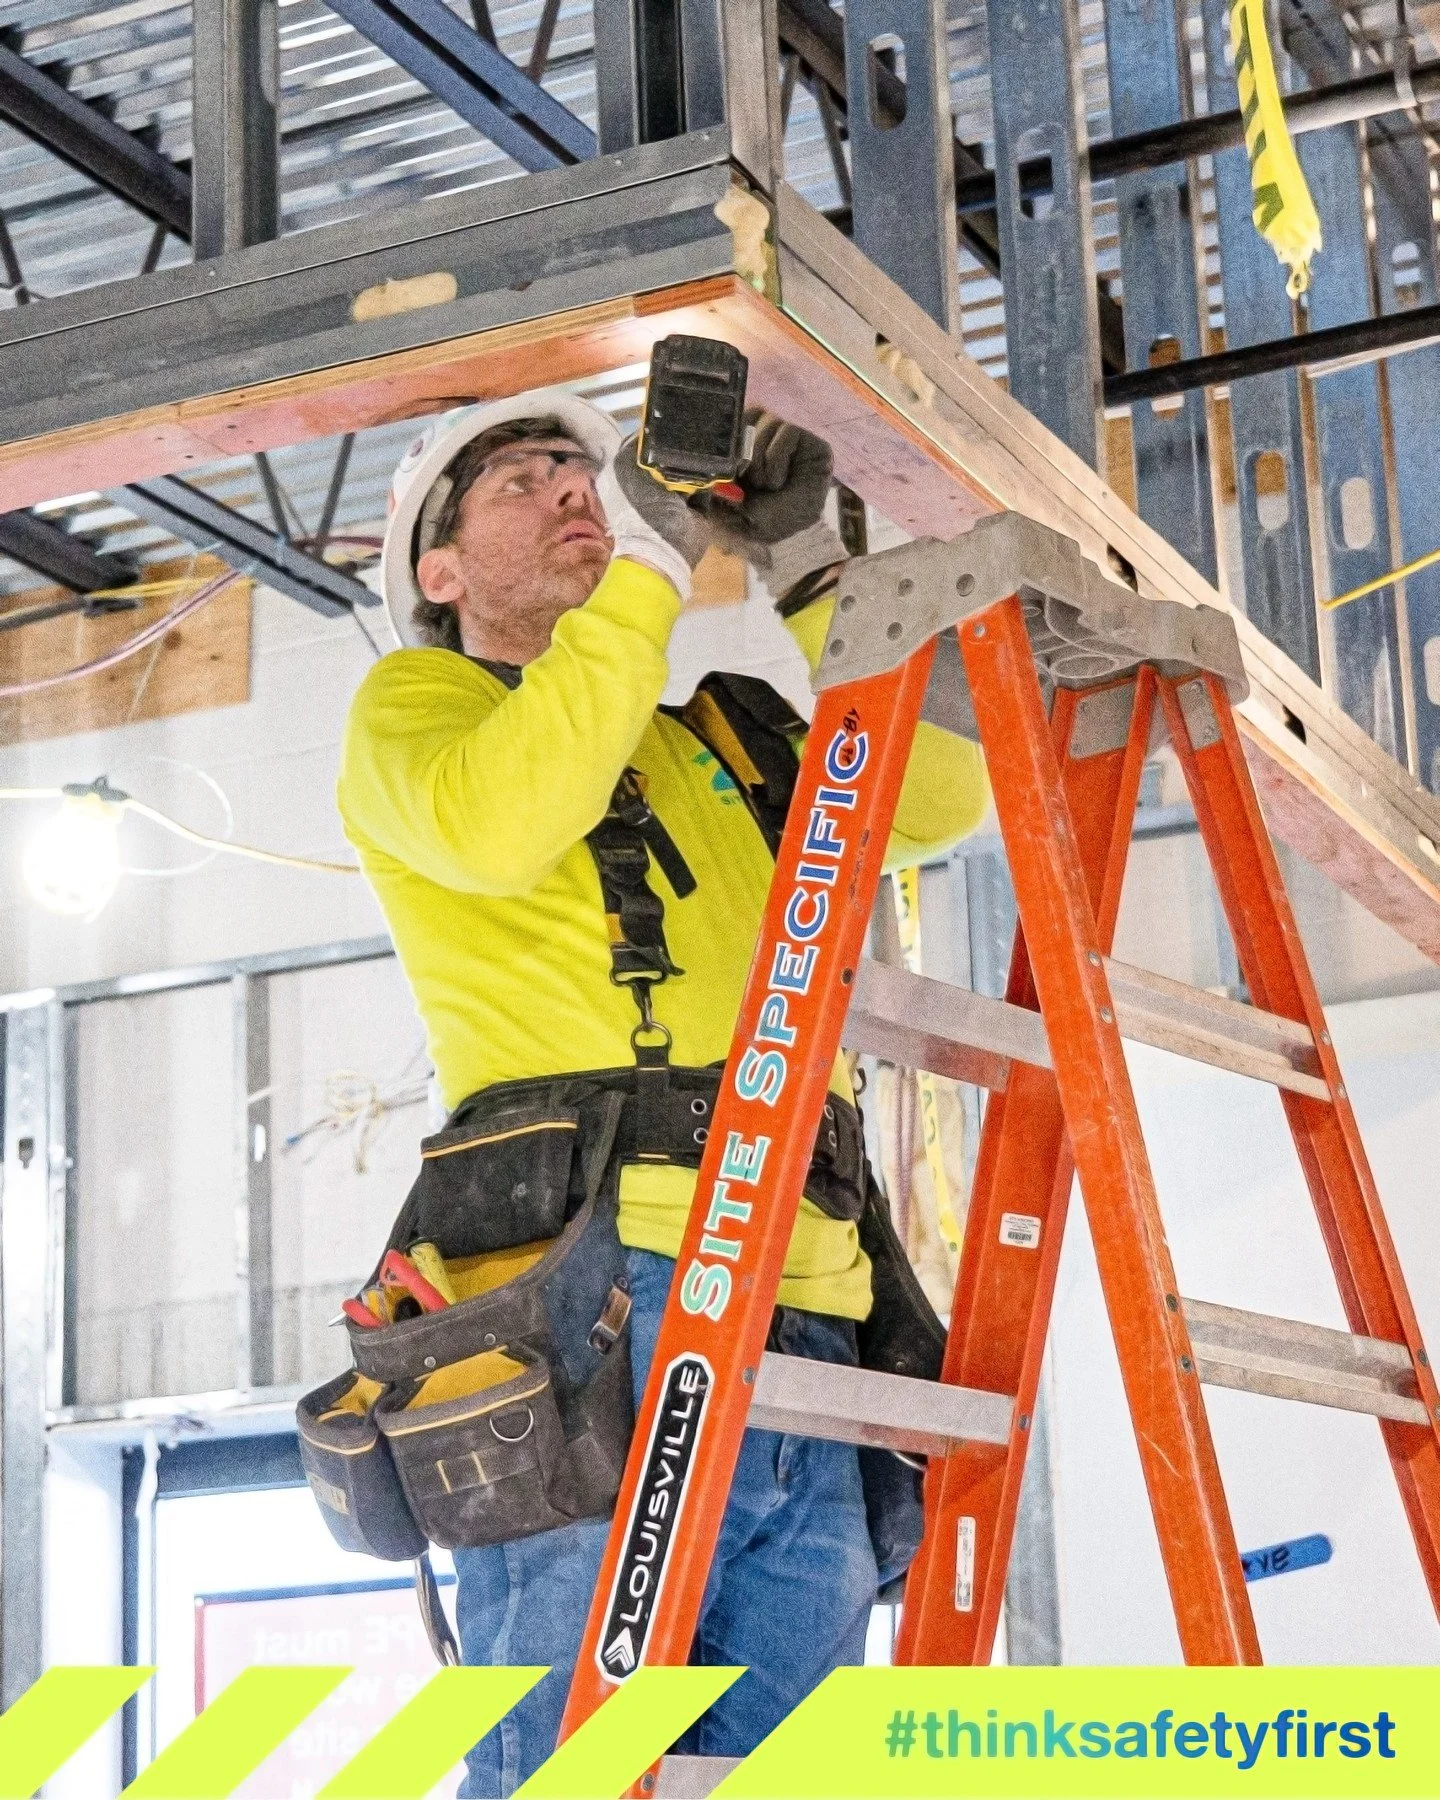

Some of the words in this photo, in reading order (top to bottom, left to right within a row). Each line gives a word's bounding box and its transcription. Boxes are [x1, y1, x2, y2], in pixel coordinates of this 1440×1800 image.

[680, 1131, 772, 1322] SITE
[735, 728, 869, 1108] SPECIFIC
[620, 1364, 702, 1623] LOUISVILLE
